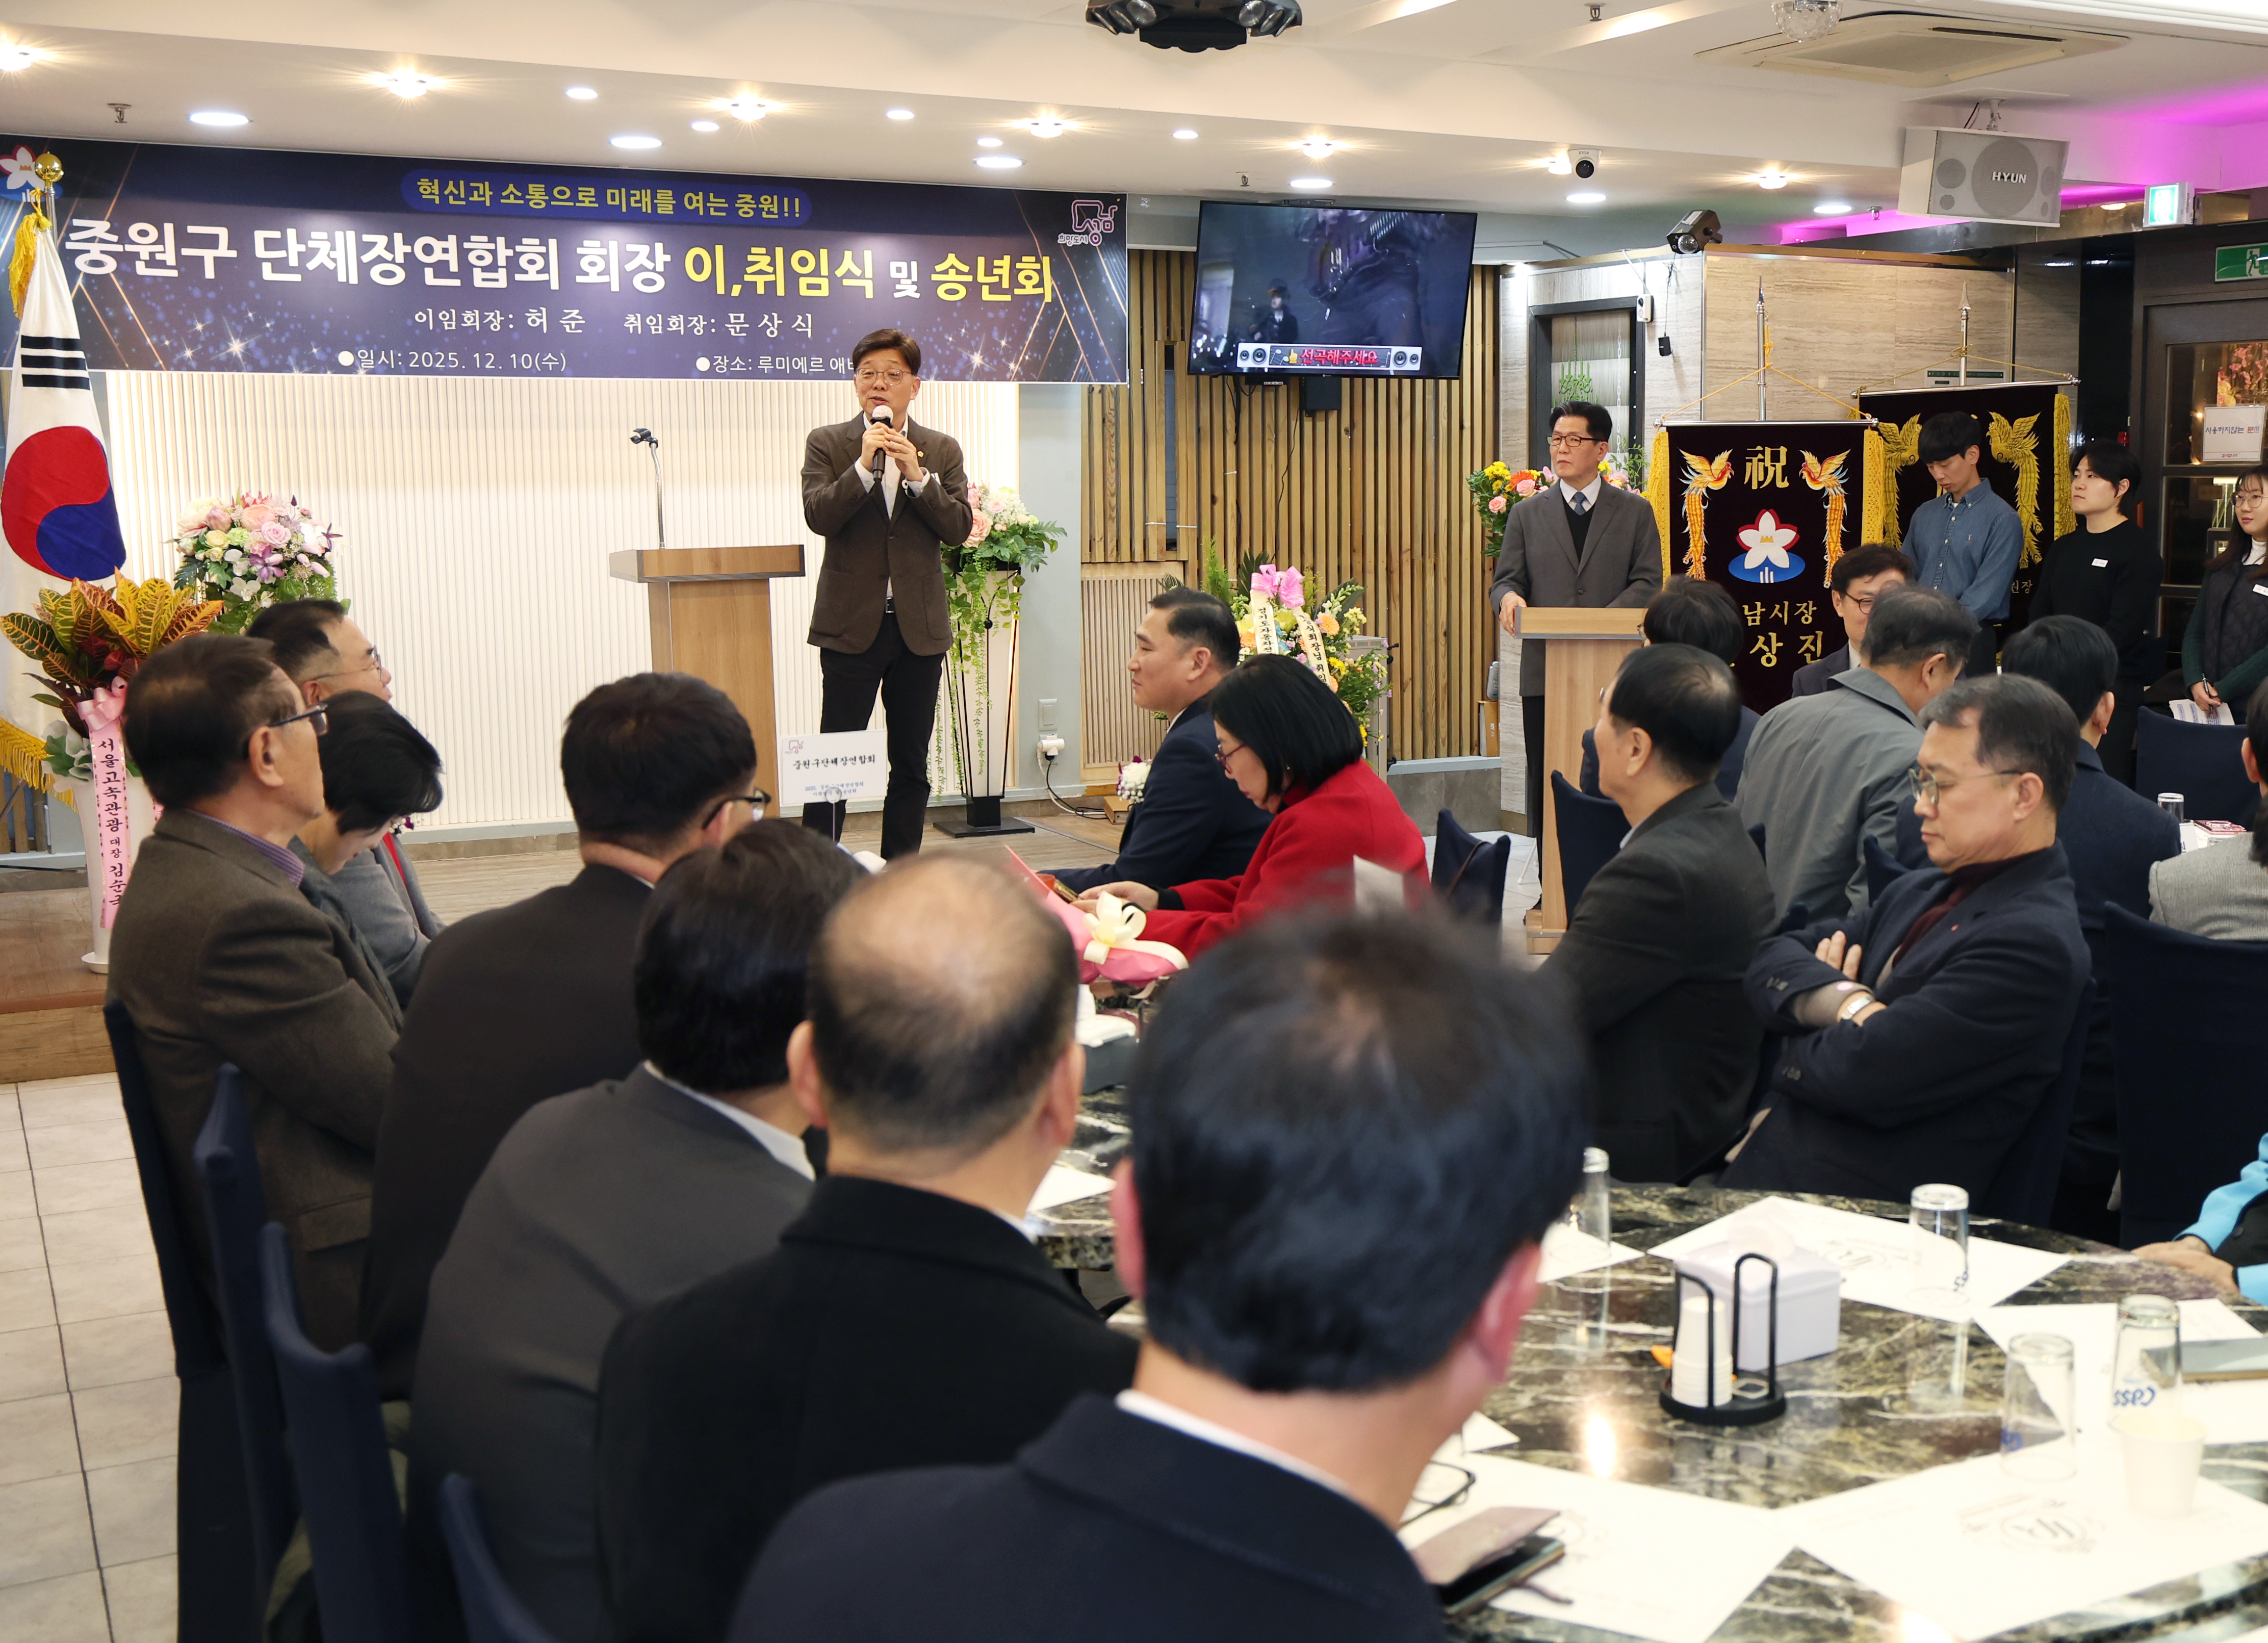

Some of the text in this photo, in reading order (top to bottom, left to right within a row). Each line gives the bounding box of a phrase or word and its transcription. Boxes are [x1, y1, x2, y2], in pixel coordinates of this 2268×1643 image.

[1992, 171, 2027, 183] HYUN
[417, 178, 800, 218] 혁신과 소통으로 미래를 여는 중원!!
[1058, 234, 1088, 247] 희망도시
[65, 218, 1053, 303] 중원구 단체장연합회 회장 이,취임식 및 송년회
[414, 307, 514, 332] 이임회장:
[623, 313, 716, 336] 취임회장:
[357, 349, 566, 372] 일시: 2025. 12. 10(수)
[713, 355, 752, 373] 장소:
[758, 356, 826, 374] 루미에르
[1301, 348, 1378, 364] 선곡해주세요
[1744, 445, 1790, 490] 祝
[97, 737, 123, 832] 서울고속관광
